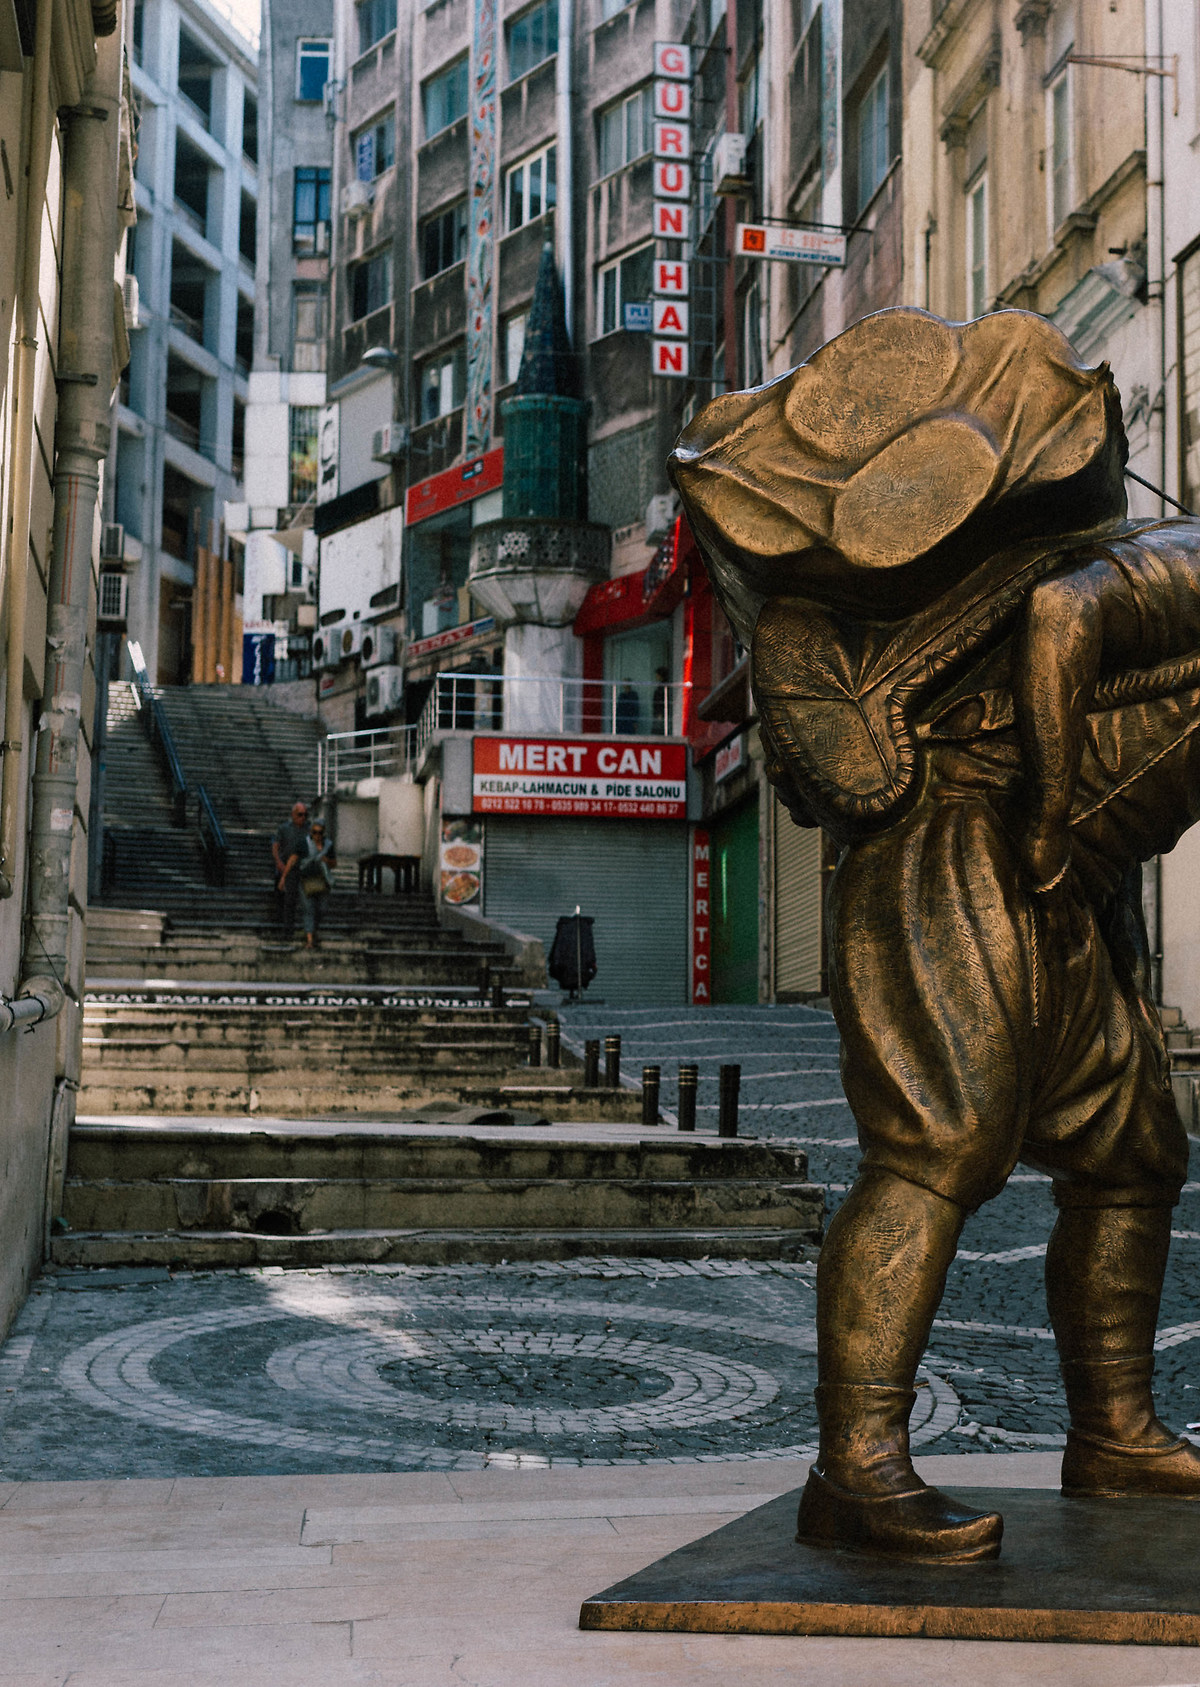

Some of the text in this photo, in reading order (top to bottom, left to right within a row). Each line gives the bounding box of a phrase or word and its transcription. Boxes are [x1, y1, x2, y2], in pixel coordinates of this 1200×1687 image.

[658, 48, 684, 372] GÜRÜN HAN
[499, 744, 662, 775] MERT CAN
[480, 781, 680, 798] KEBAP-LAHMACUN & PİDE SALONU
[481, 798, 502, 809] 0212
[618, 802, 638, 813] 0532
[668, 804, 678, 814] 27
